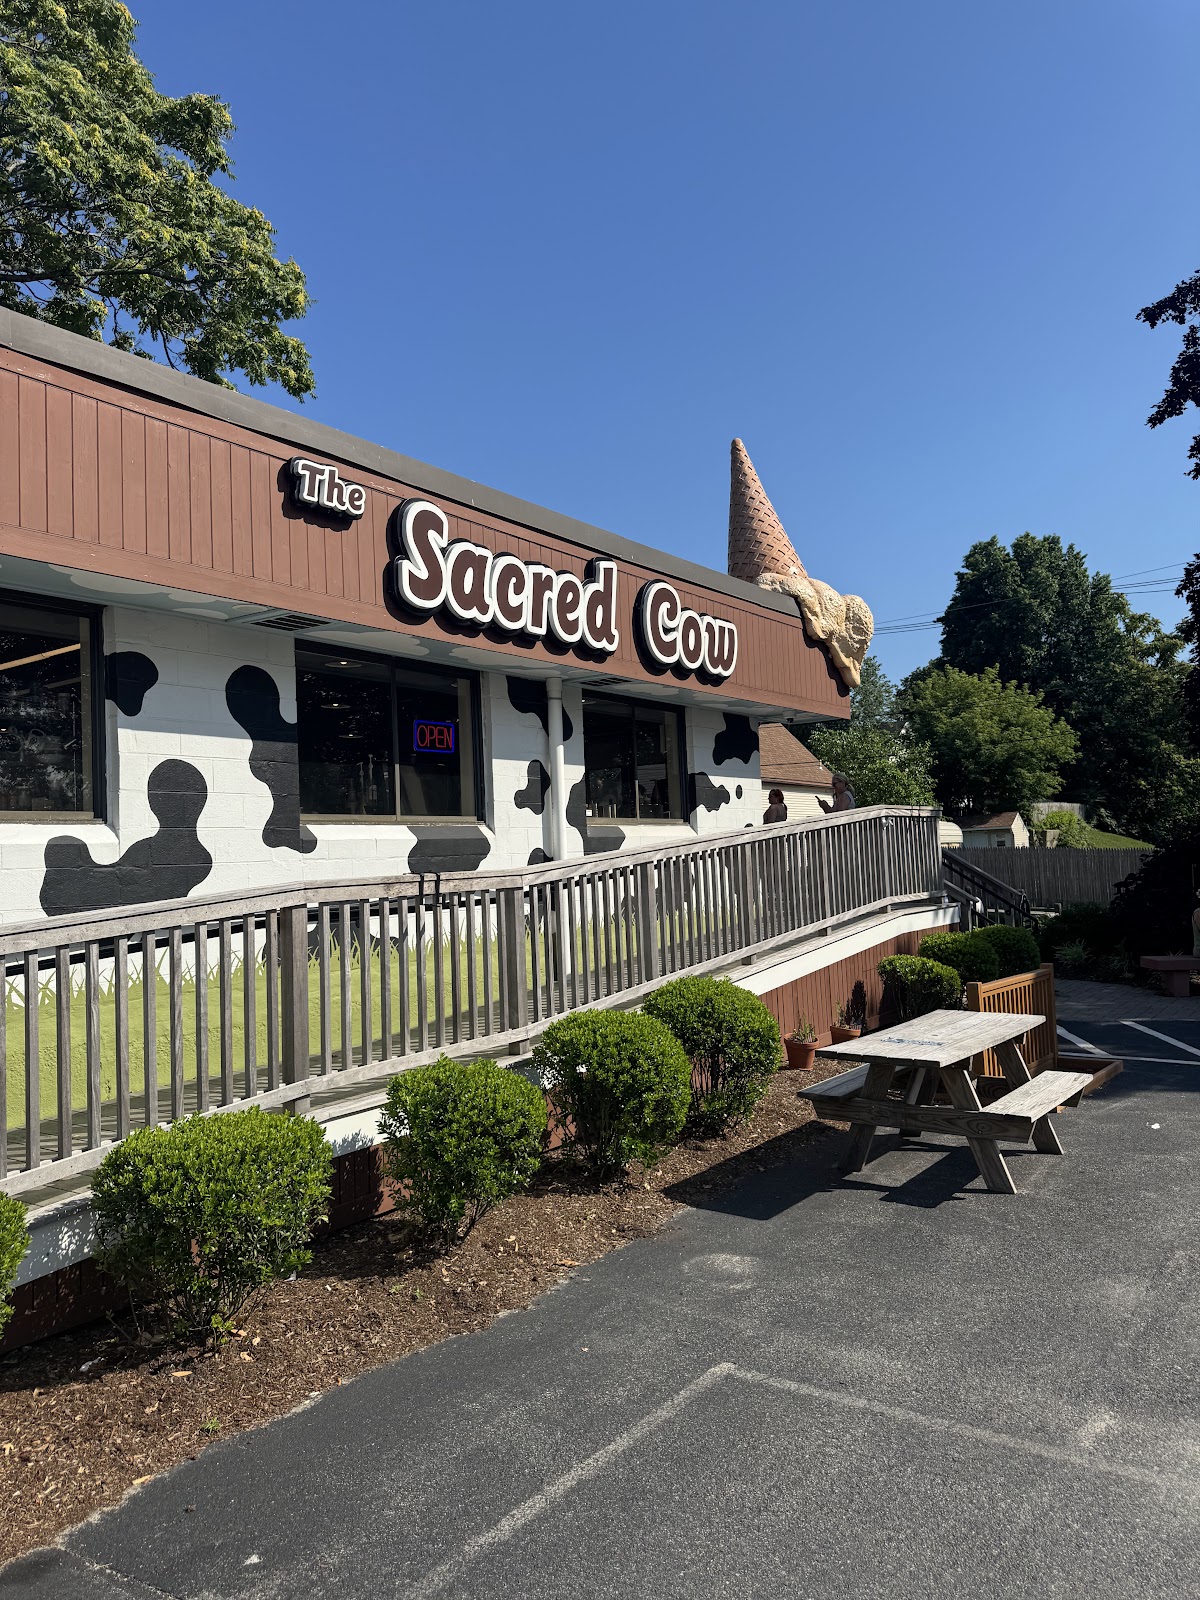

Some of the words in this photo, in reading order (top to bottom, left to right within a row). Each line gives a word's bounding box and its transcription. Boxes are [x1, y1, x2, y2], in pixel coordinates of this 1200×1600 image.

[297, 459, 366, 515] The
[401, 499, 620, 652] Sacred
[644, 581, 738, 677] Cow
[417, 725, 453, 748] OPEN
